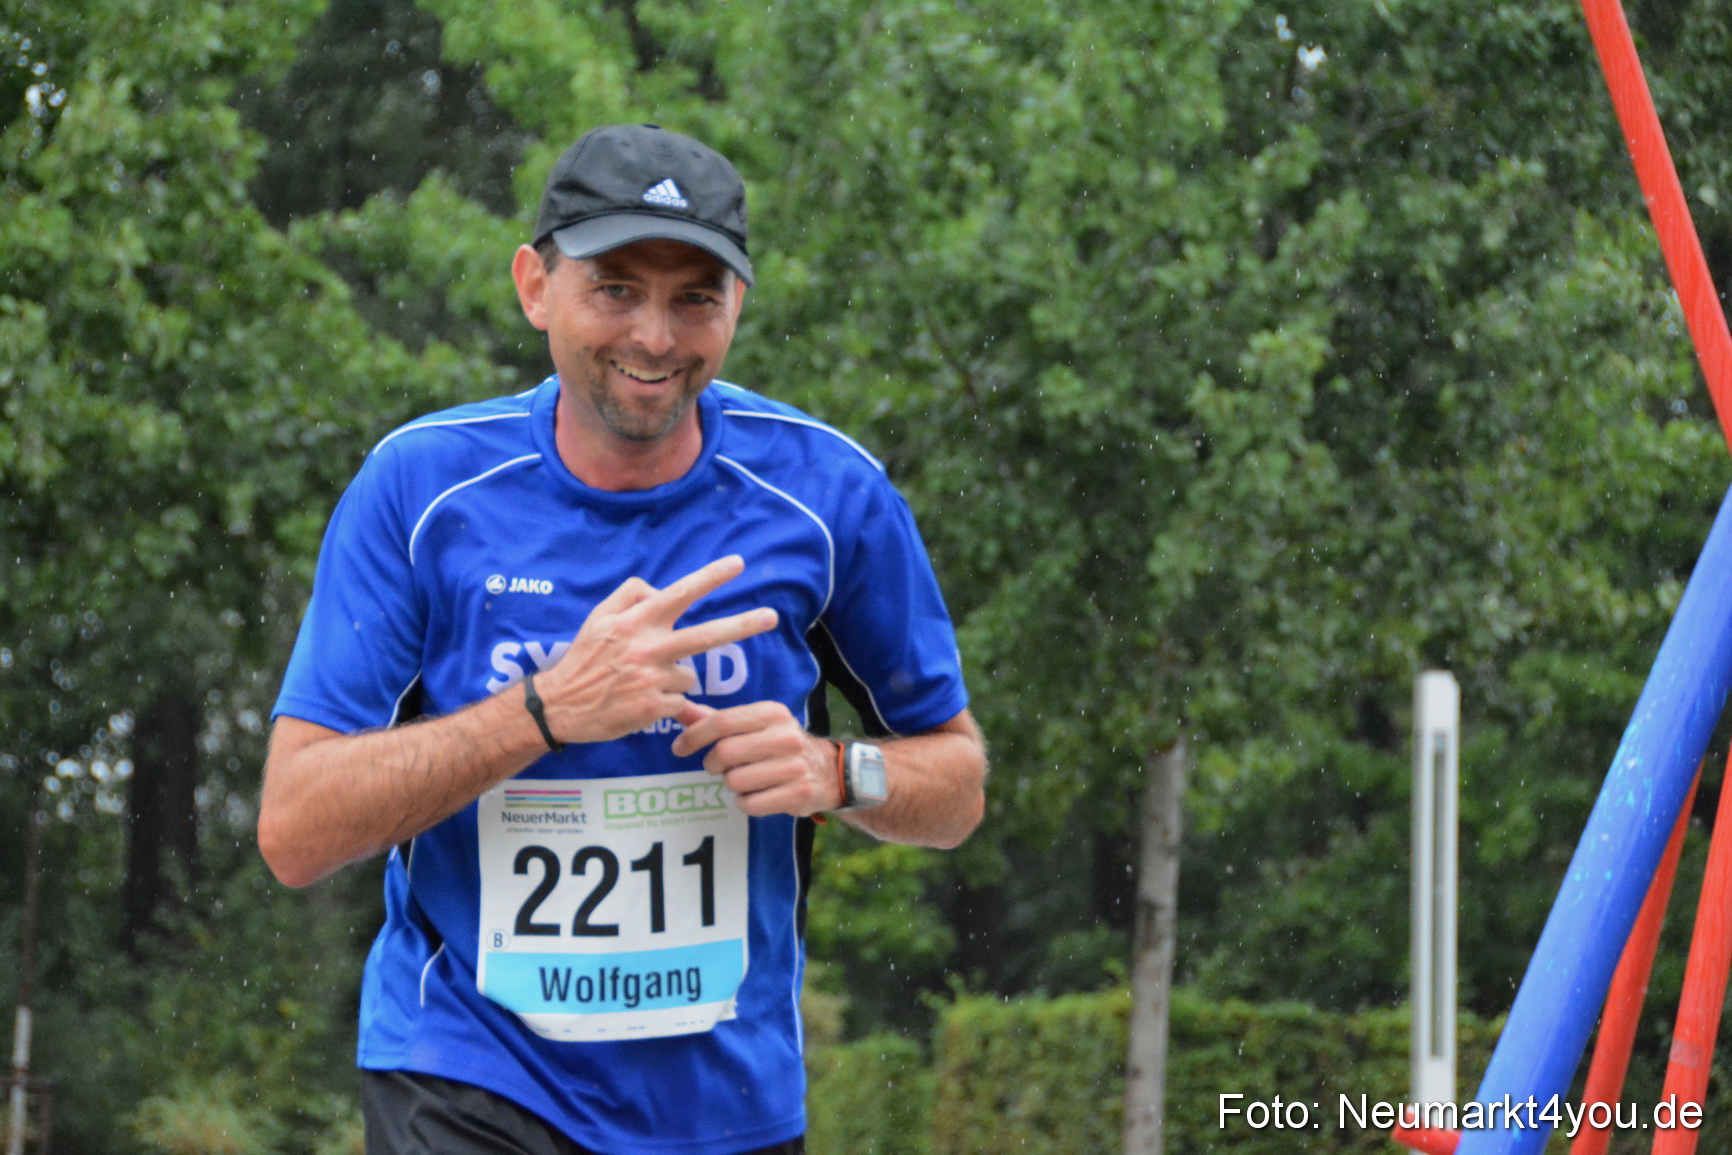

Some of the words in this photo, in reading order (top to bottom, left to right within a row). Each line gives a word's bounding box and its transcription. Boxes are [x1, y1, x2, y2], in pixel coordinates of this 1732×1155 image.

[643, 193, 688, 208] adidas
[508, 577, 553, 595] JAKO
[603, 781, 728, 819] BOCK
[501, 811, 587, 825] NeuerMarkt
[513, 835, 716, 937] 2211
[493, 932, 503, 948] B
[538, 966, 701, 1008] Wolfgang
